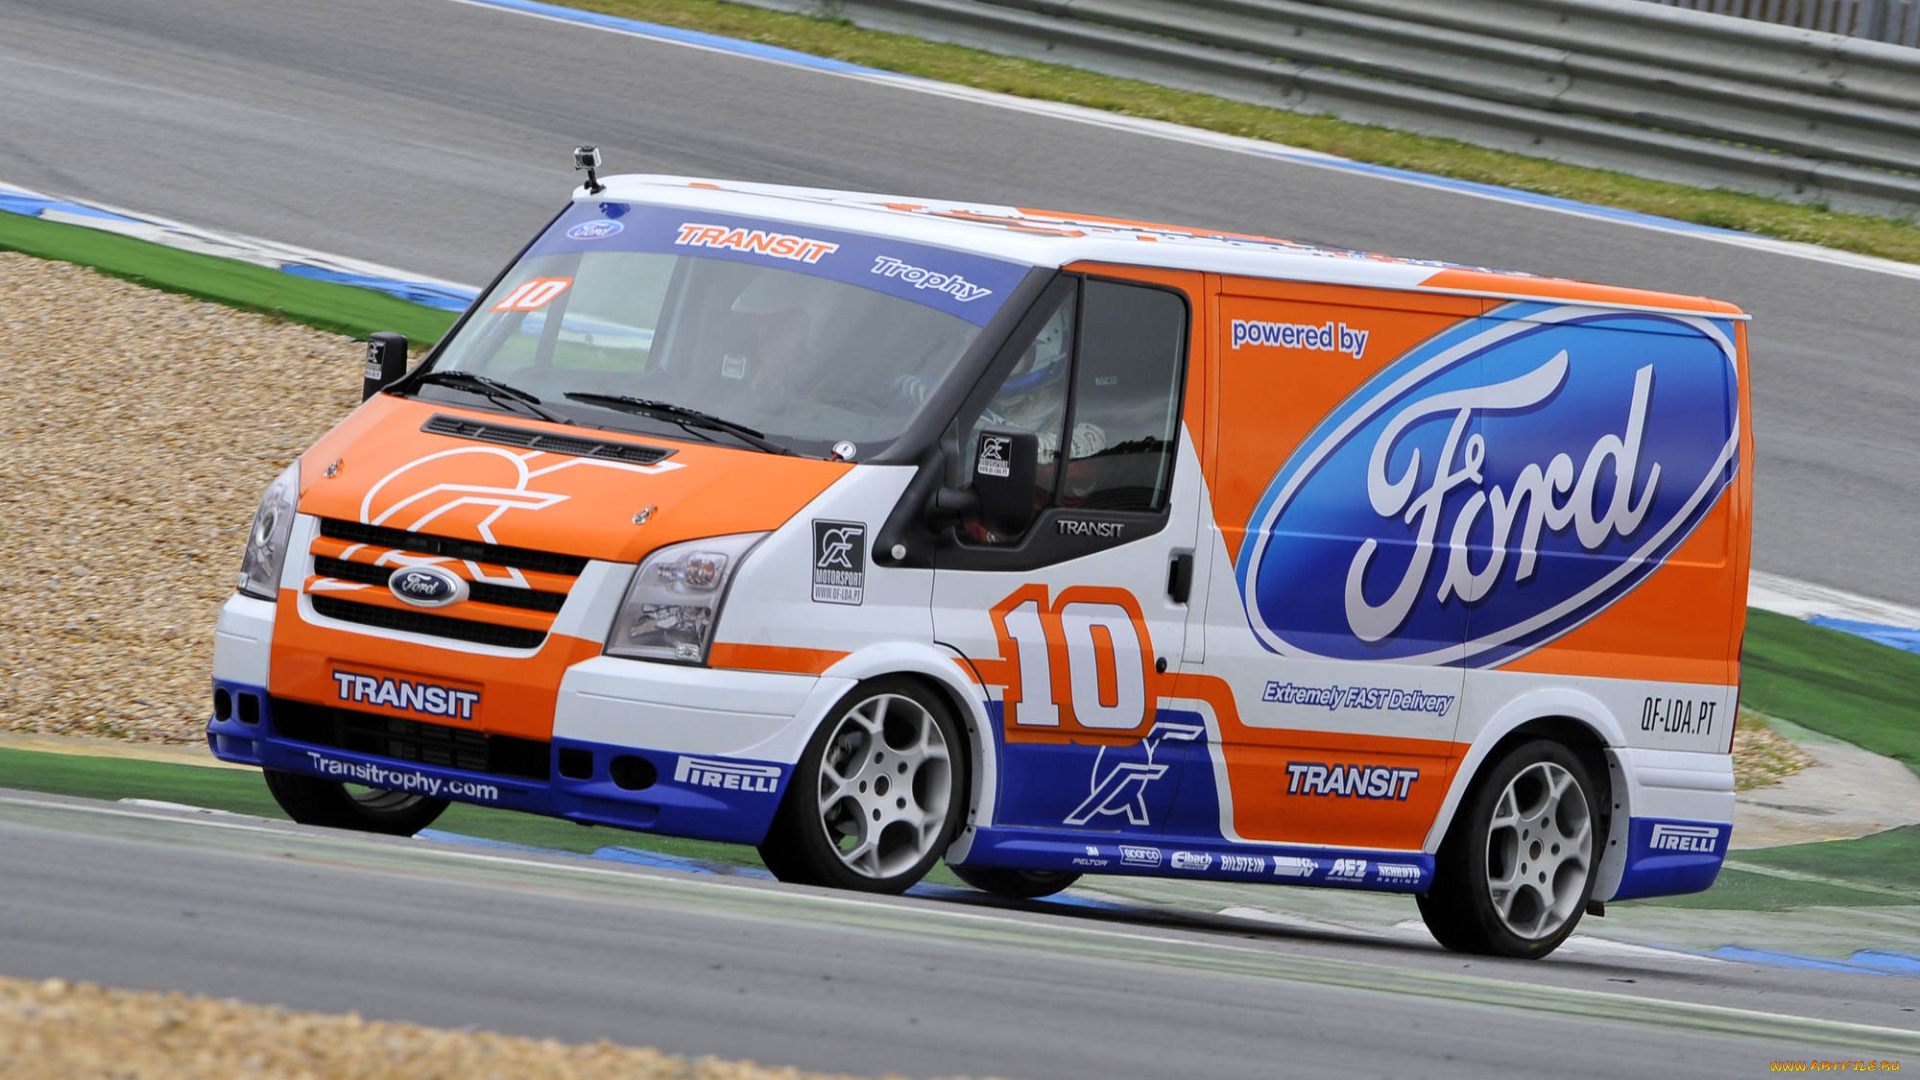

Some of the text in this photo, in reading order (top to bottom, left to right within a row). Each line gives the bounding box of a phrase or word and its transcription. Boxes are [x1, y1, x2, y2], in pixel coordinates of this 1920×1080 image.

[675, 223, 992, 302] TRANSIT Trophy
[494, 279, 570, 311] 10
[1231, 319, 1369, 359] powered by
[1344, 350, 1662, 641] Ford
[1057, 519, 1125, 538] TRANSIT
[401, 571, 439, 597] Ford
[816, 569, 862, 586] MOTORSPORT
[1002, 598, 1147, 730] 10
[333, 669, 480, 720] TRANSIT
[1262, 681, 1454, 717] Extremely FAST Delivery
[1641, 696, 1717, 735] QF-LDA.PT
[307, 751, 499, 800] Transitrophy.com
[673, 755, 782, 793] PIRELLI
[1286, 761, 1420, 801] TRANSIT
[1650, 823, 1720, 852] PIRELLI
[1171, 850, 1213, 870] Eibach
[1221, 855, 1266, 873] BILSTEIN
[1328, 858, 1367, 878] AEZ
